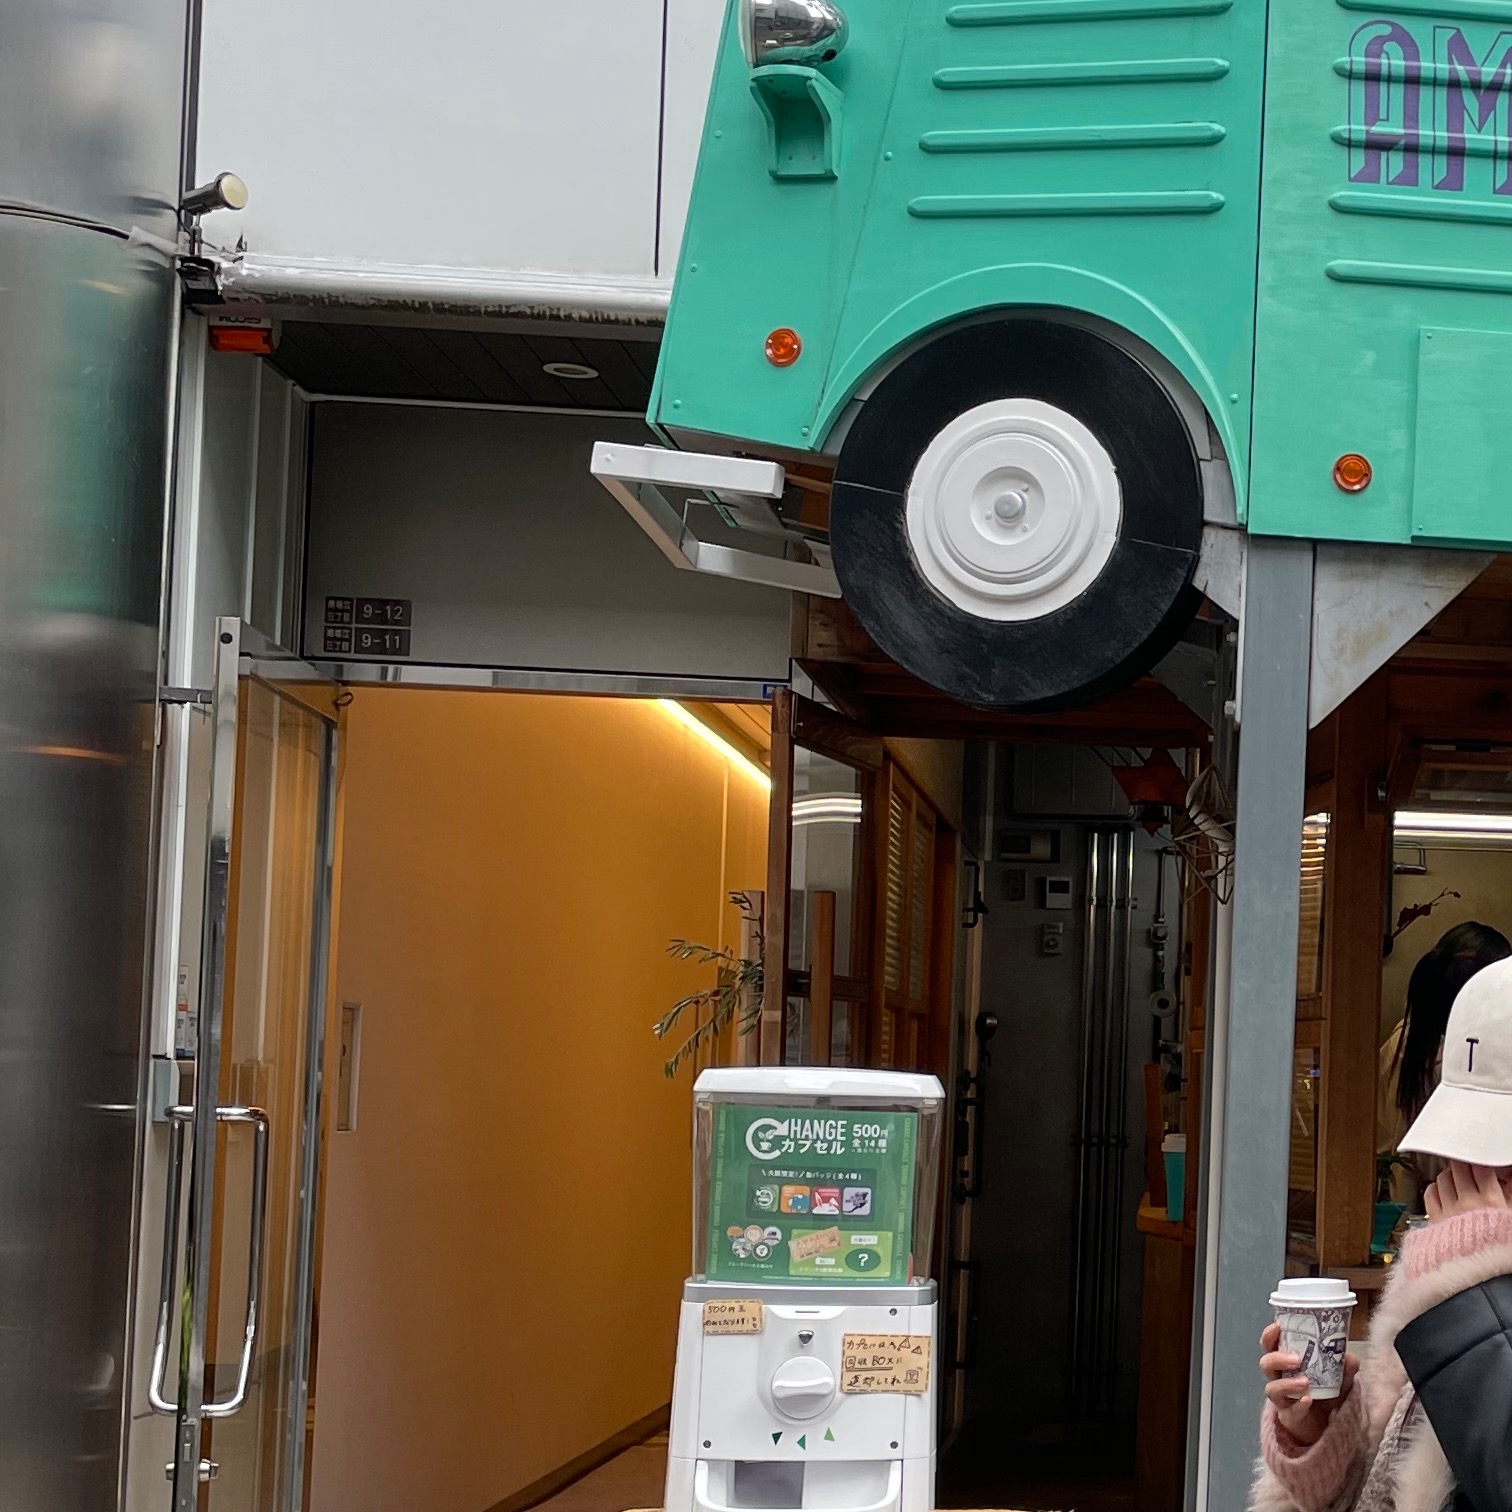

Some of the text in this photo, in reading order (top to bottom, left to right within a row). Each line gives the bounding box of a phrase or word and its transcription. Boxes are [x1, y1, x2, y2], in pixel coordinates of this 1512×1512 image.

[362, 604, 403, 620] 9-12
[361, 633, 400, 649] 9-11
[1466, 1037, 1479, 1073] T
[852, 1124, 888, 1138] 500円
[781, 1139, 845, 1155] カプセル
